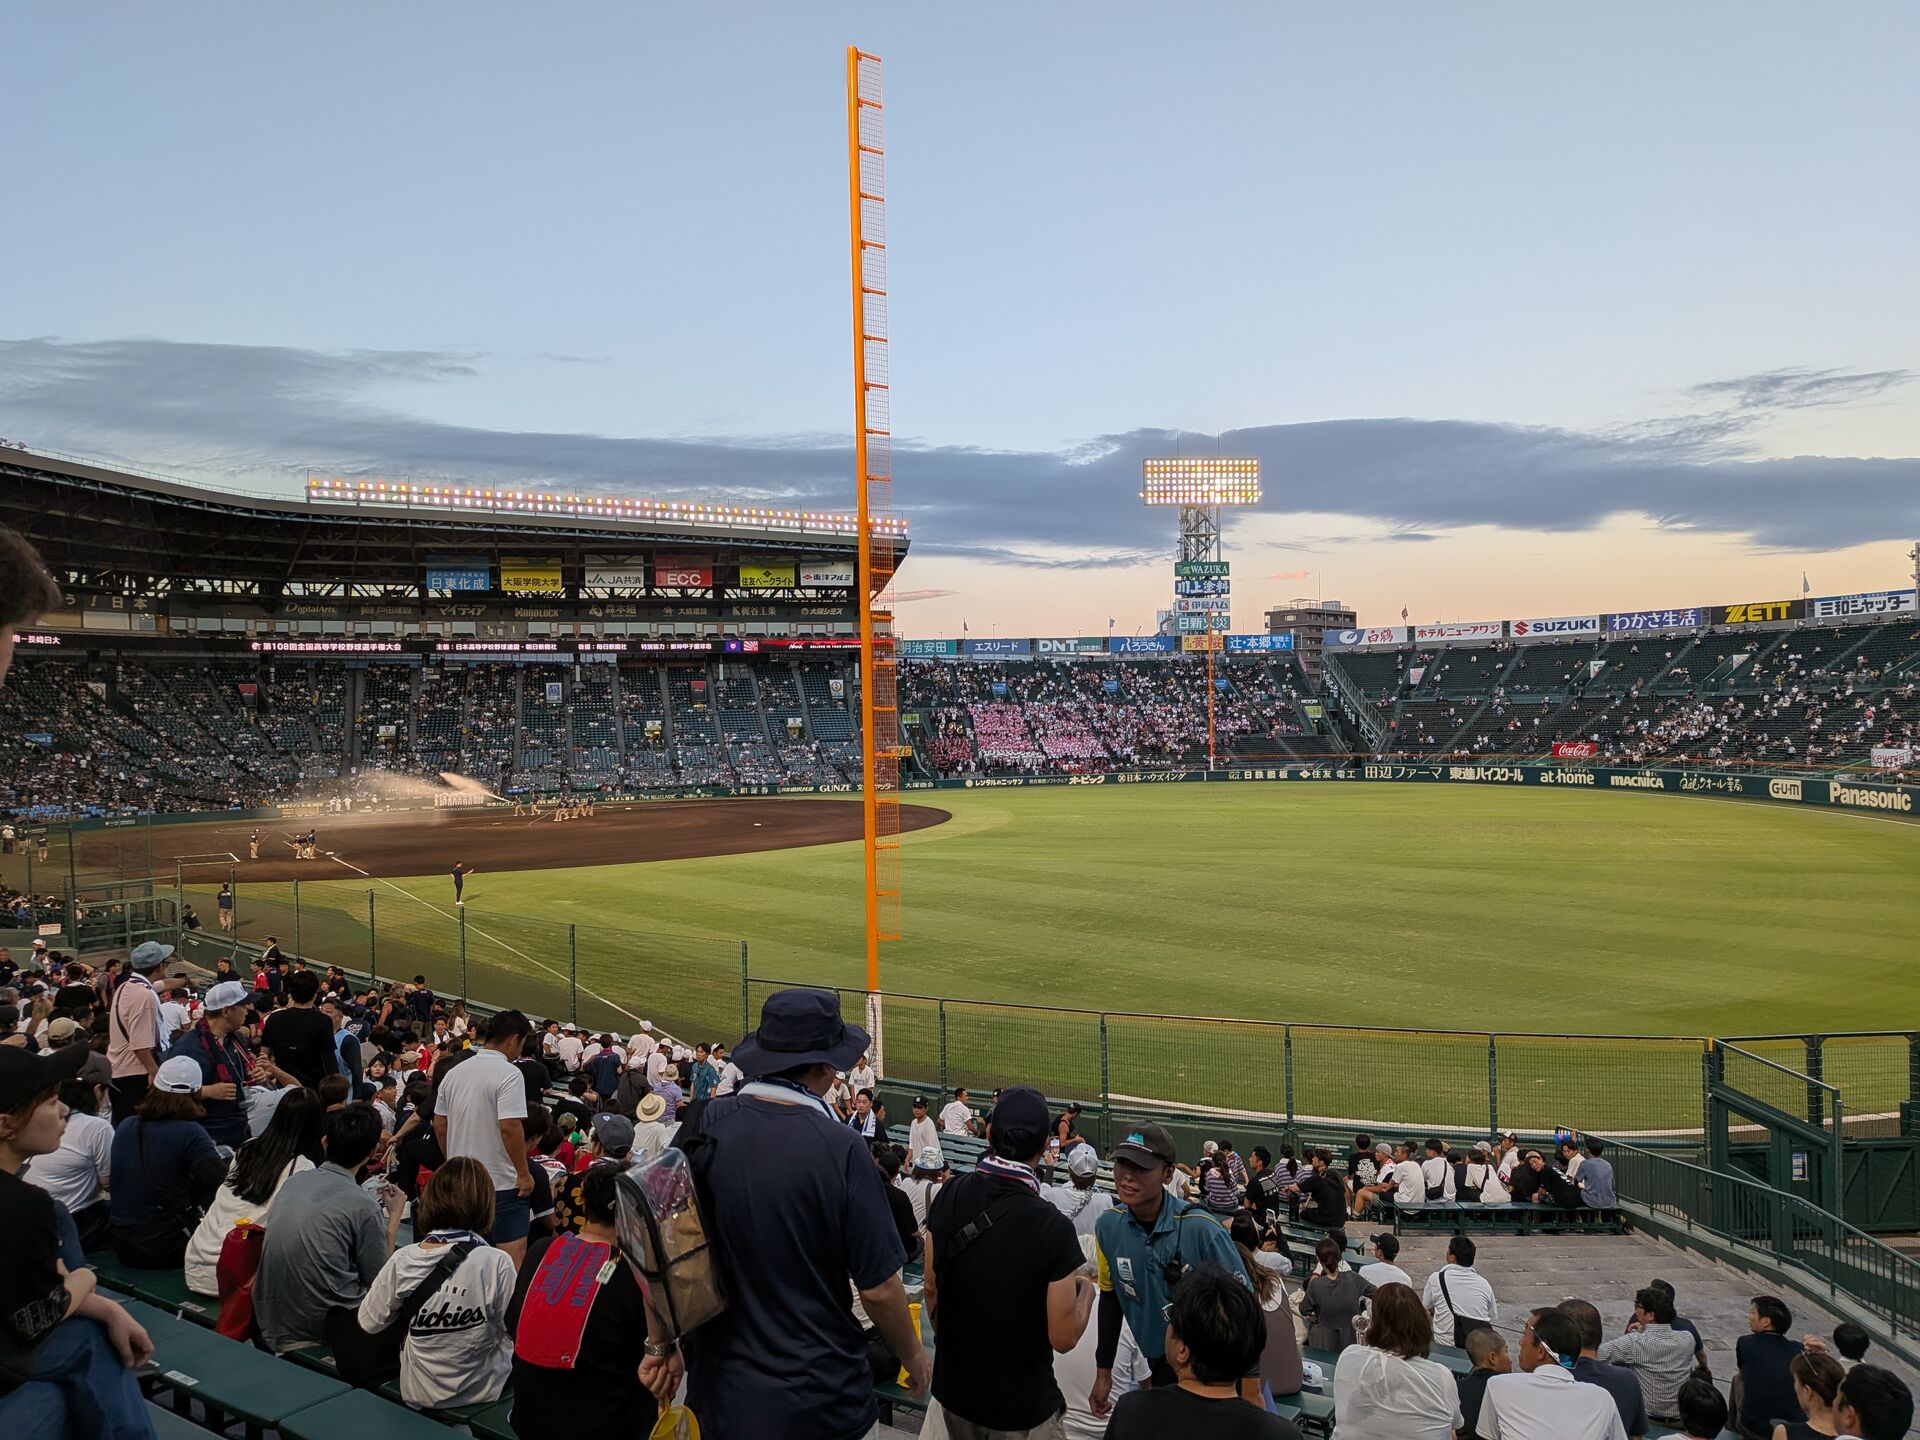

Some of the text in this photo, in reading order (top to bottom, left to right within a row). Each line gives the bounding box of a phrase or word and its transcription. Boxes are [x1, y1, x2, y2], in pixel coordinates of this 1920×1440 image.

[1191, 565, 1228, 574] WAZUKA
[431, 577, 485, 590] 日東化成
[504, 577, 560, 587] 大阪学院大学
[608, 575, 642, 585] JA共済
[667, 573, 701, 586] ECC
[742, 577, 793, 587] 住友ベークライト
[1177, 581, 1228, 594] 川上塗料
[1191, 601, 1228, 609] 伊藤ハム
[1820, 596, 1910, 616] 三和シャッター
[1725, 602, 1791, 623] ZETT
[1532, 619, 1597, 633] SUZUKI
[1613, 609, 1697, 630] わかさ生活
[1367, 629, 1394, 643] 白鶴
[1417, 625, 1501, 638] ホテルニューアワジ
[975, 642, 1019, 651] エスリード
[1039, 640, 1078, 651] DNT
[1131, 641, 1165, 651] ろうきん
[1126, 773, 1187, 782] 日本ハウズイング
[1244, 770, 1288, 779] 日鉄鋼板
[1365, 766, 1442, 779] 田辺ファーマ
[1450, 767, 1523, 782] 東進ハイスクール
[1556, 769, 1595, 784] home
[975, 779, 1024, 787] レンタルのニッケン
[1068, 775, 1105, 785] オービック
[1700, 776, 1743, 792] クオール薬局
[820, 783, 851, 793] GUNZE
[1829, 781, 1911, 811] Panasonic
